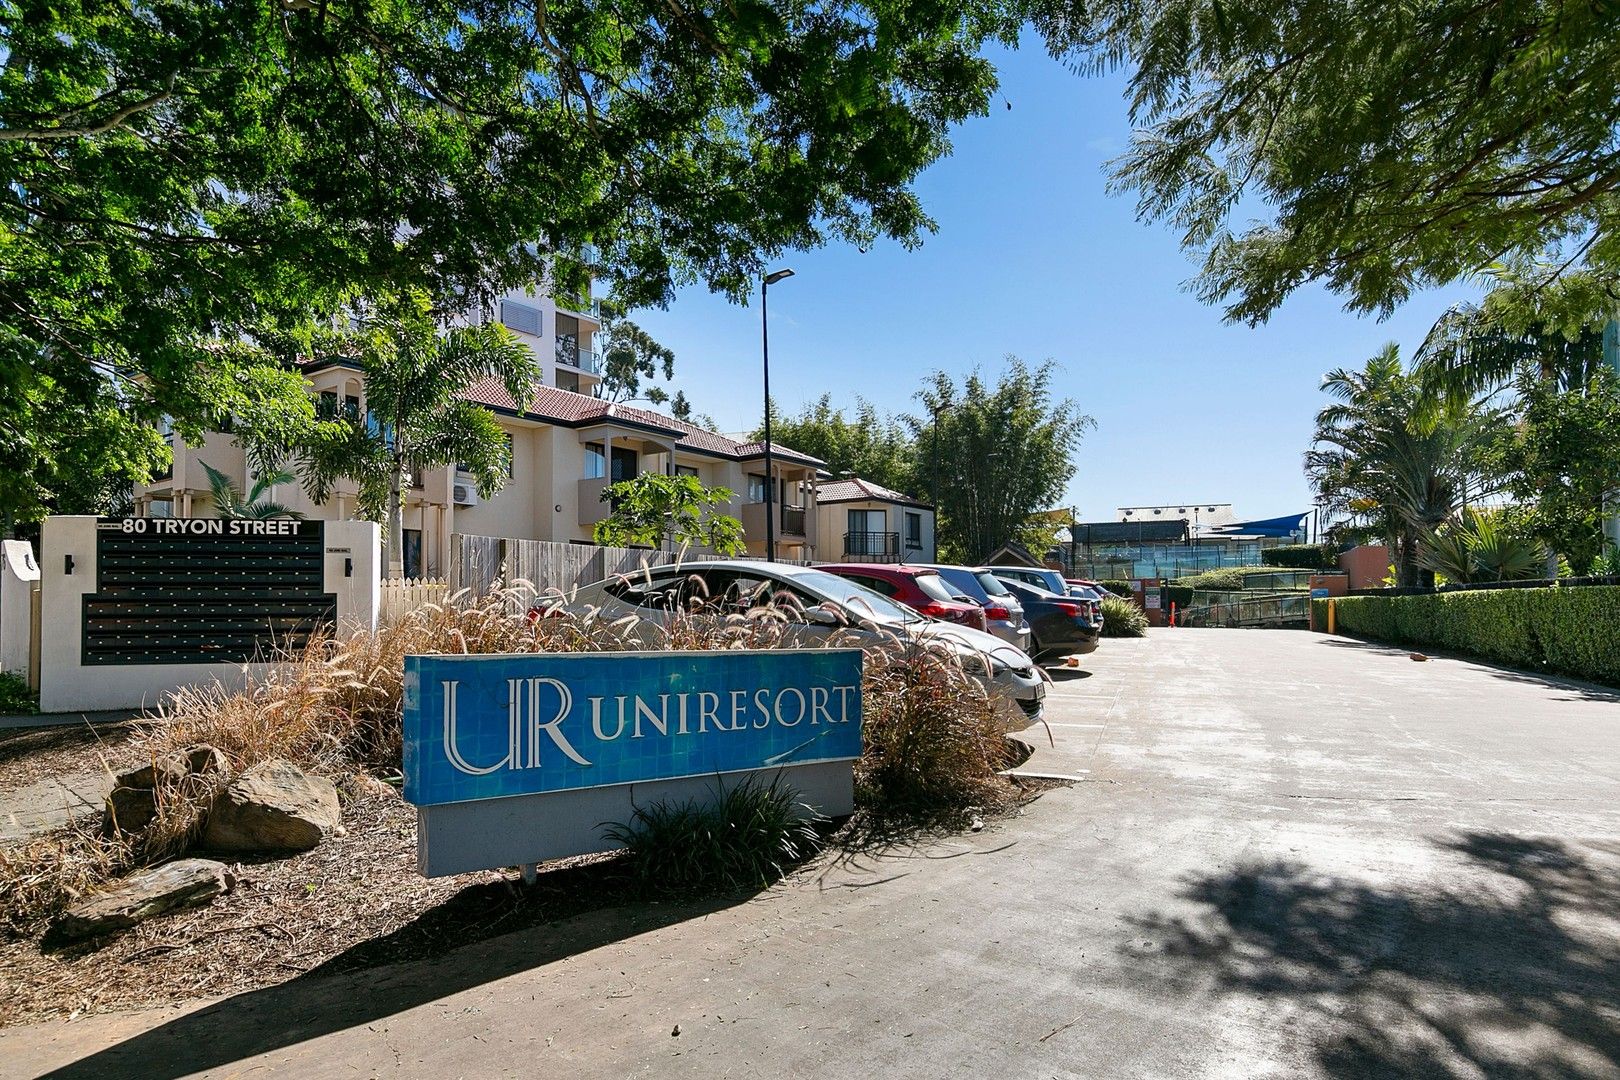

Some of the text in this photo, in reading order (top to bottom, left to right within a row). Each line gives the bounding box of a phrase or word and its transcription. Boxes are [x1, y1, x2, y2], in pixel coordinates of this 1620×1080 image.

[122, 519, 301, 535] 80 TRYON STREET
[441, 678, 855, 775] UR UNIRESORT
